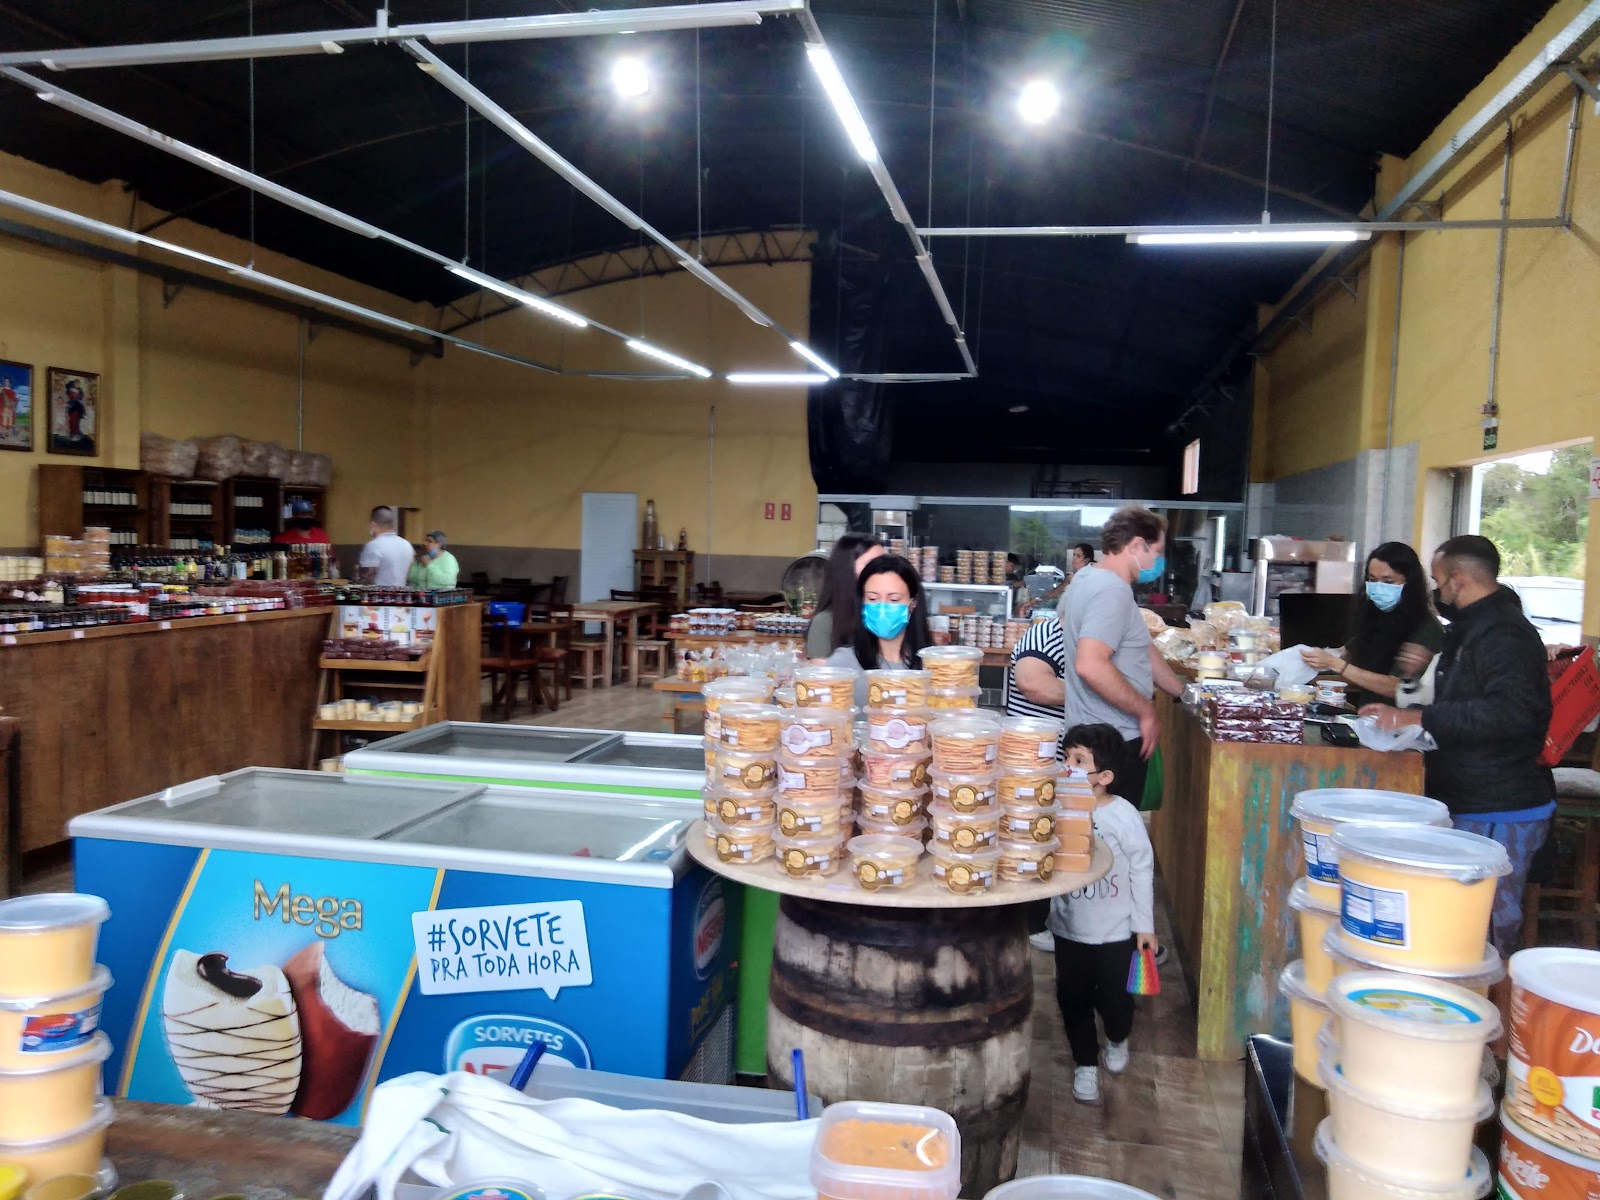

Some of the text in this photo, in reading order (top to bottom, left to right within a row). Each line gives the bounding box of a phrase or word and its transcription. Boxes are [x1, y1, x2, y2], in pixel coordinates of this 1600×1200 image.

[253, 879, 362, 939] Mega
[427, 911, 565, 955] #SORVETE
[430, 949, 580, 982] PRA TODA HORA
[474, 1025, 564, 1051] SORVETES
